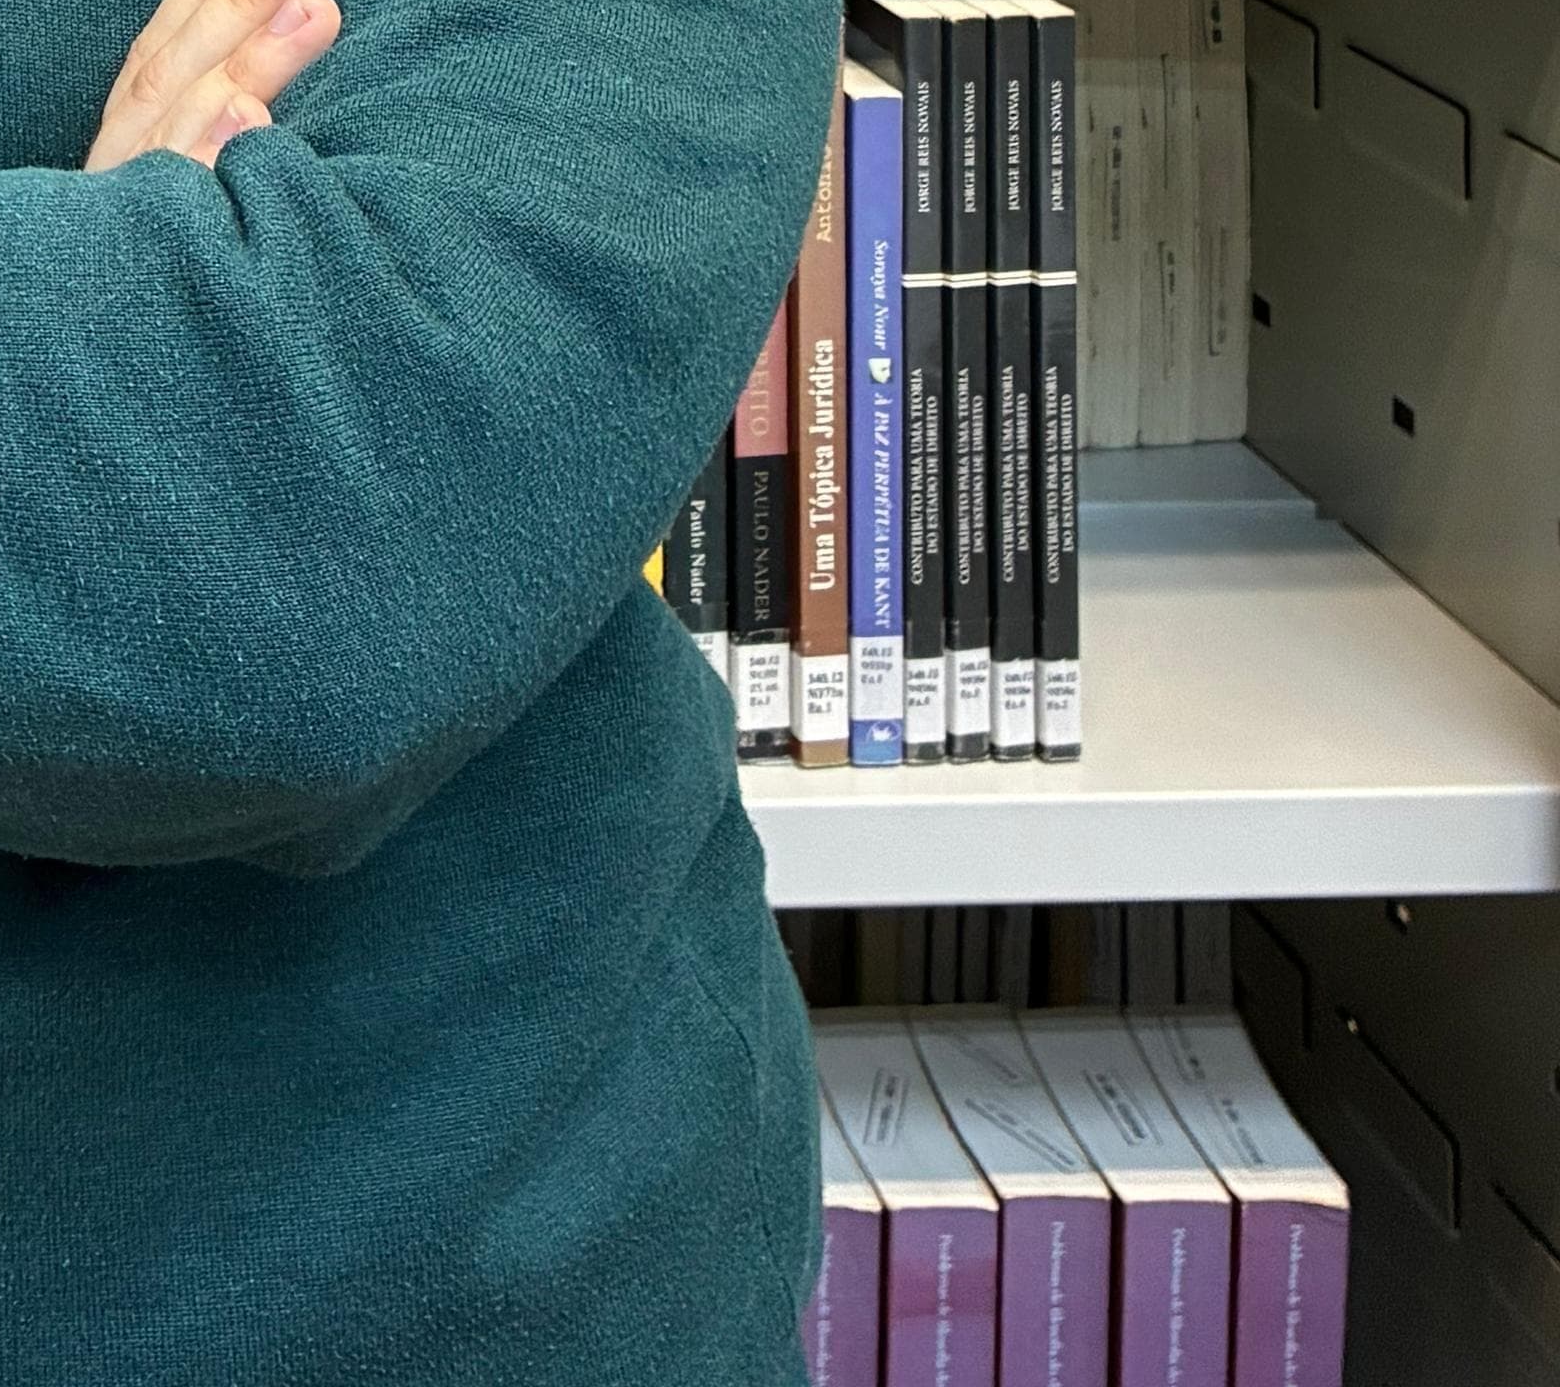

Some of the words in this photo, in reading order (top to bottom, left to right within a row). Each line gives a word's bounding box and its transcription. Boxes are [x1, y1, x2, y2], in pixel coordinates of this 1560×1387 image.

[917, 81, 929, 133] NOVAIS
[917, 136, 930, 166] REIS
[917, 171, 931, 213] JORGE
[807, 339, 834, 439] Jurídica
[910, 368, 923, 419] TEORIA
[910, 421, 923, 454] UMA
[926, 395, 938, 453] DIREITO
[808, 445, 841, 529] Tópica
[910, 456, 923, 491] PARA
[926, 457, 938, 474] DE
[690, 500, 706, 549] Paulo
[753, 471, 769, 541] PAULO
[926, 476, 939, 530] ESTADO
[809, 533, 835, 591] Uma
[910, 492, 924, 585] CONTRIBUTO
[926, 531, 939, 554] DO
[690, 553, 706, 605] Nader
[753, 547, 770, 622] NADER
